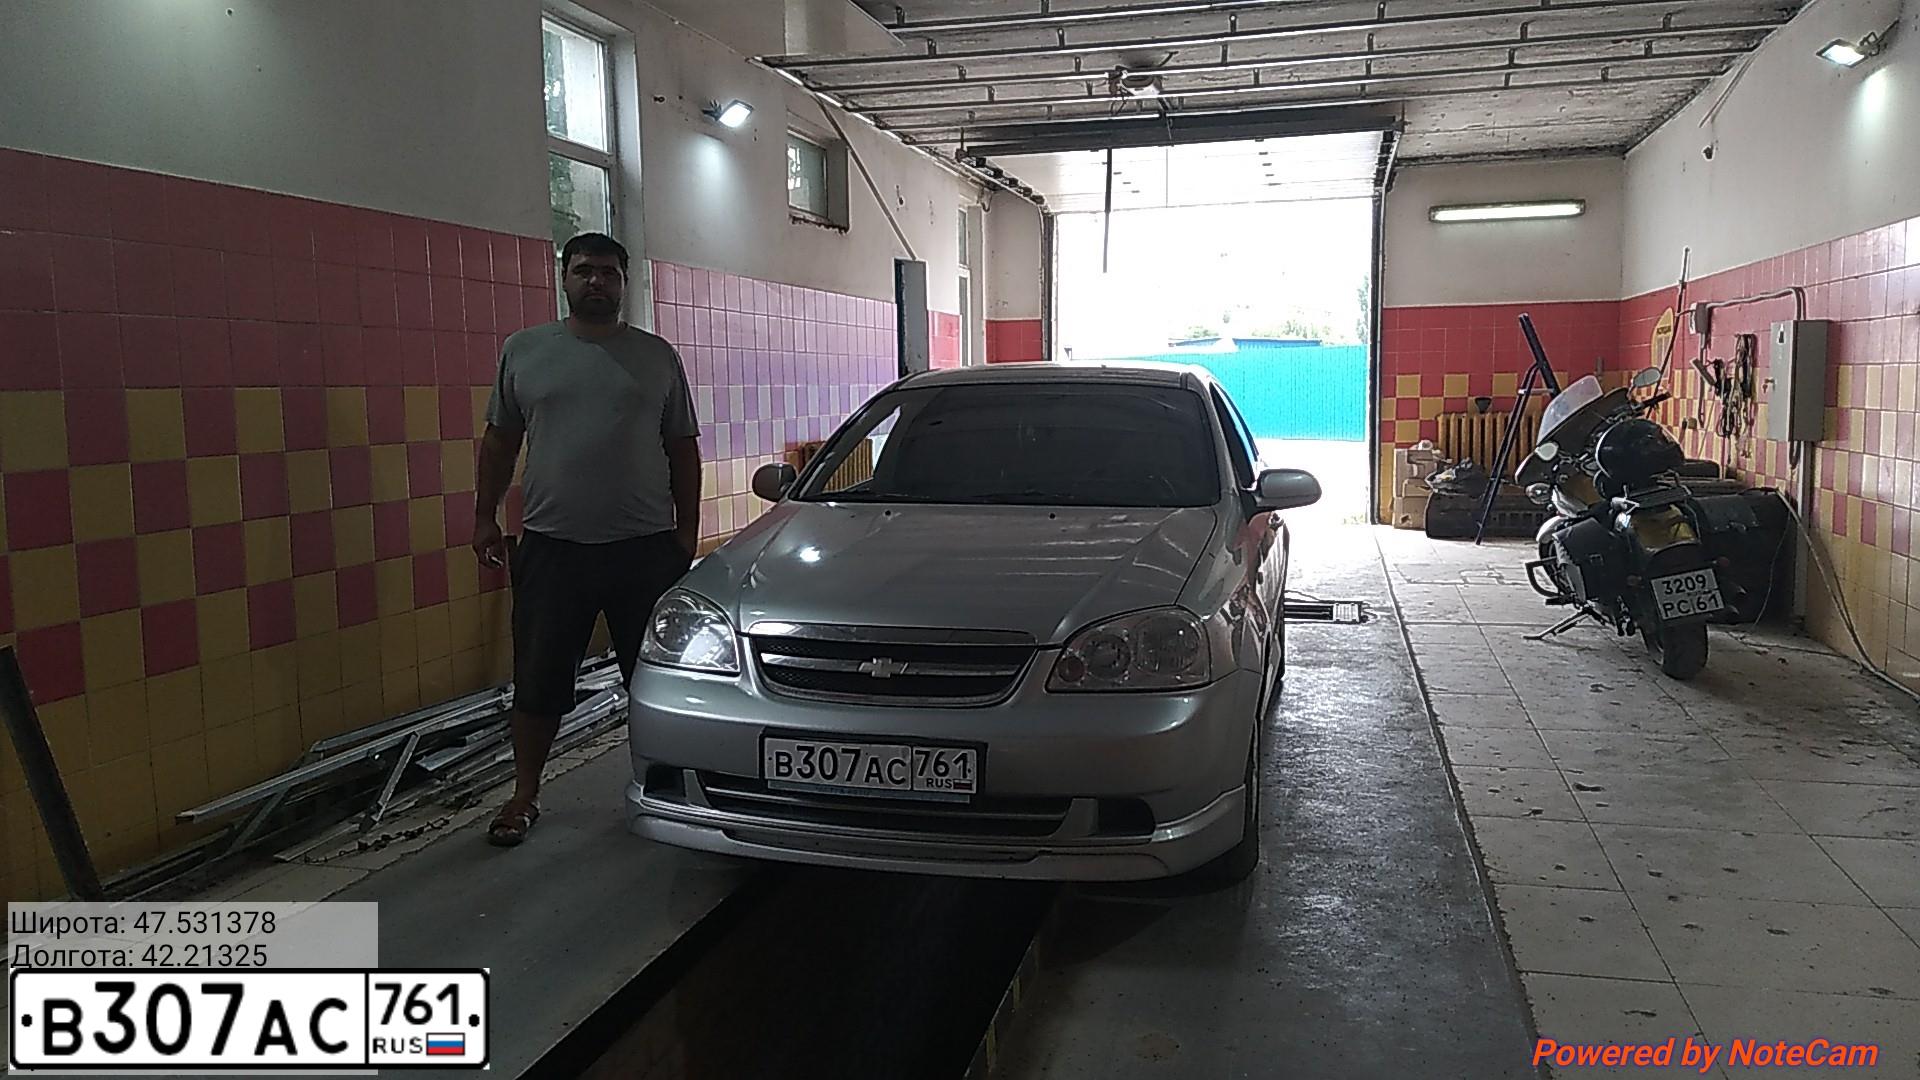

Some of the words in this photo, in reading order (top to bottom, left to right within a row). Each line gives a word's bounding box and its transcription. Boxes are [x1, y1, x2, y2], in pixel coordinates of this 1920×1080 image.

[1661, 574, 1707, 595] 3209
[1696, 594, 1720, 611] 61
[914, 749, 969, 780] 761
[926, 778, 953, 789] RUS
